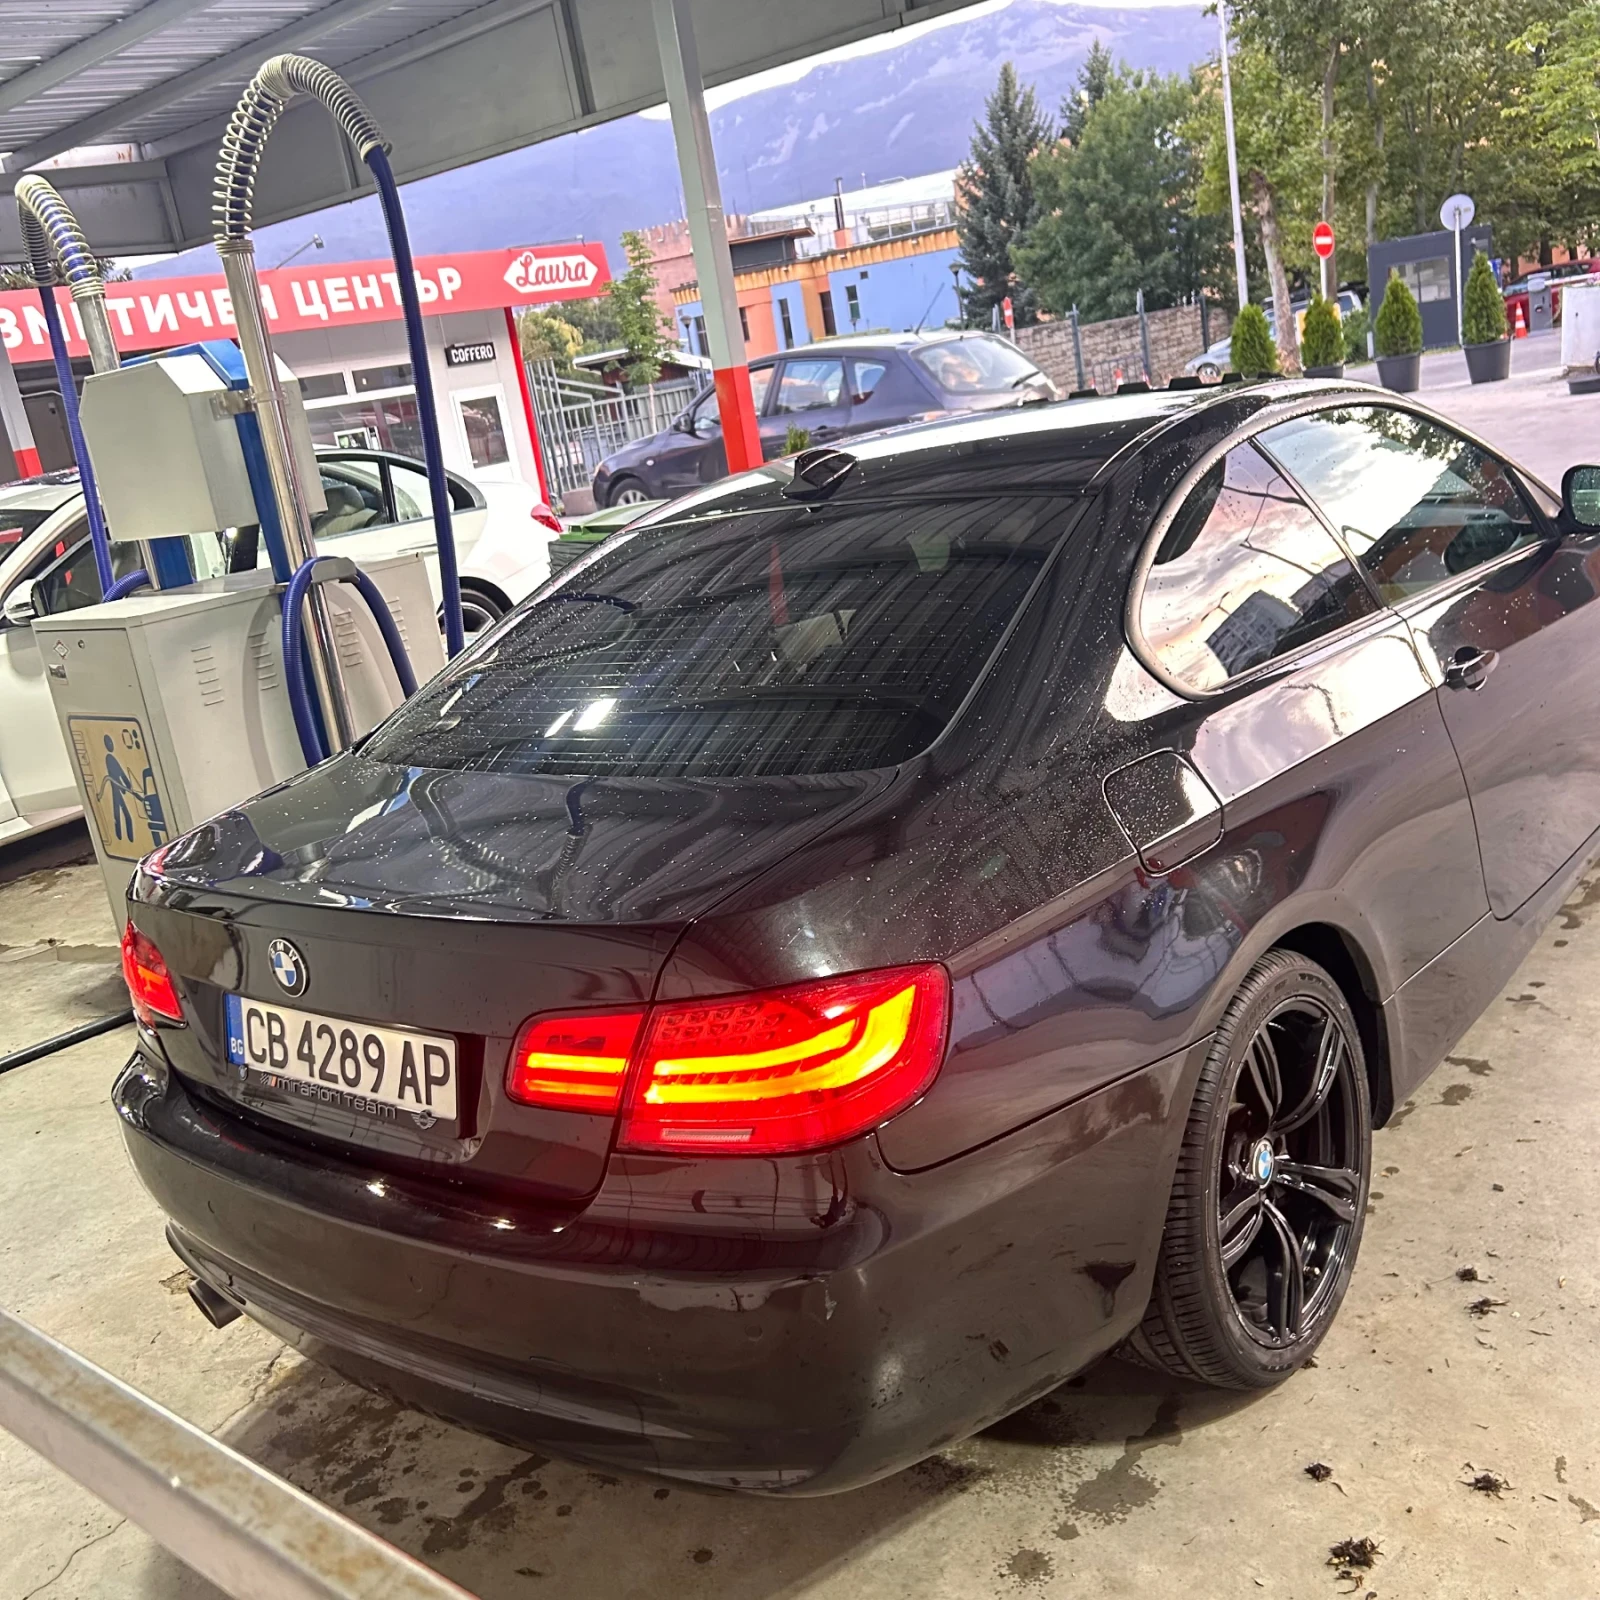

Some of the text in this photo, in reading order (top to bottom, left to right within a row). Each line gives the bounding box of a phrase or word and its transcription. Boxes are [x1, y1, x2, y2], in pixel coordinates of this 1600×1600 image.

[516, 254, 588, 287] Laura
[451, 344, 494, 364] COFFERO
[231, 1037, 244, 1056] BG
[246, 1008, 450, 1106] CB 4289 AP
